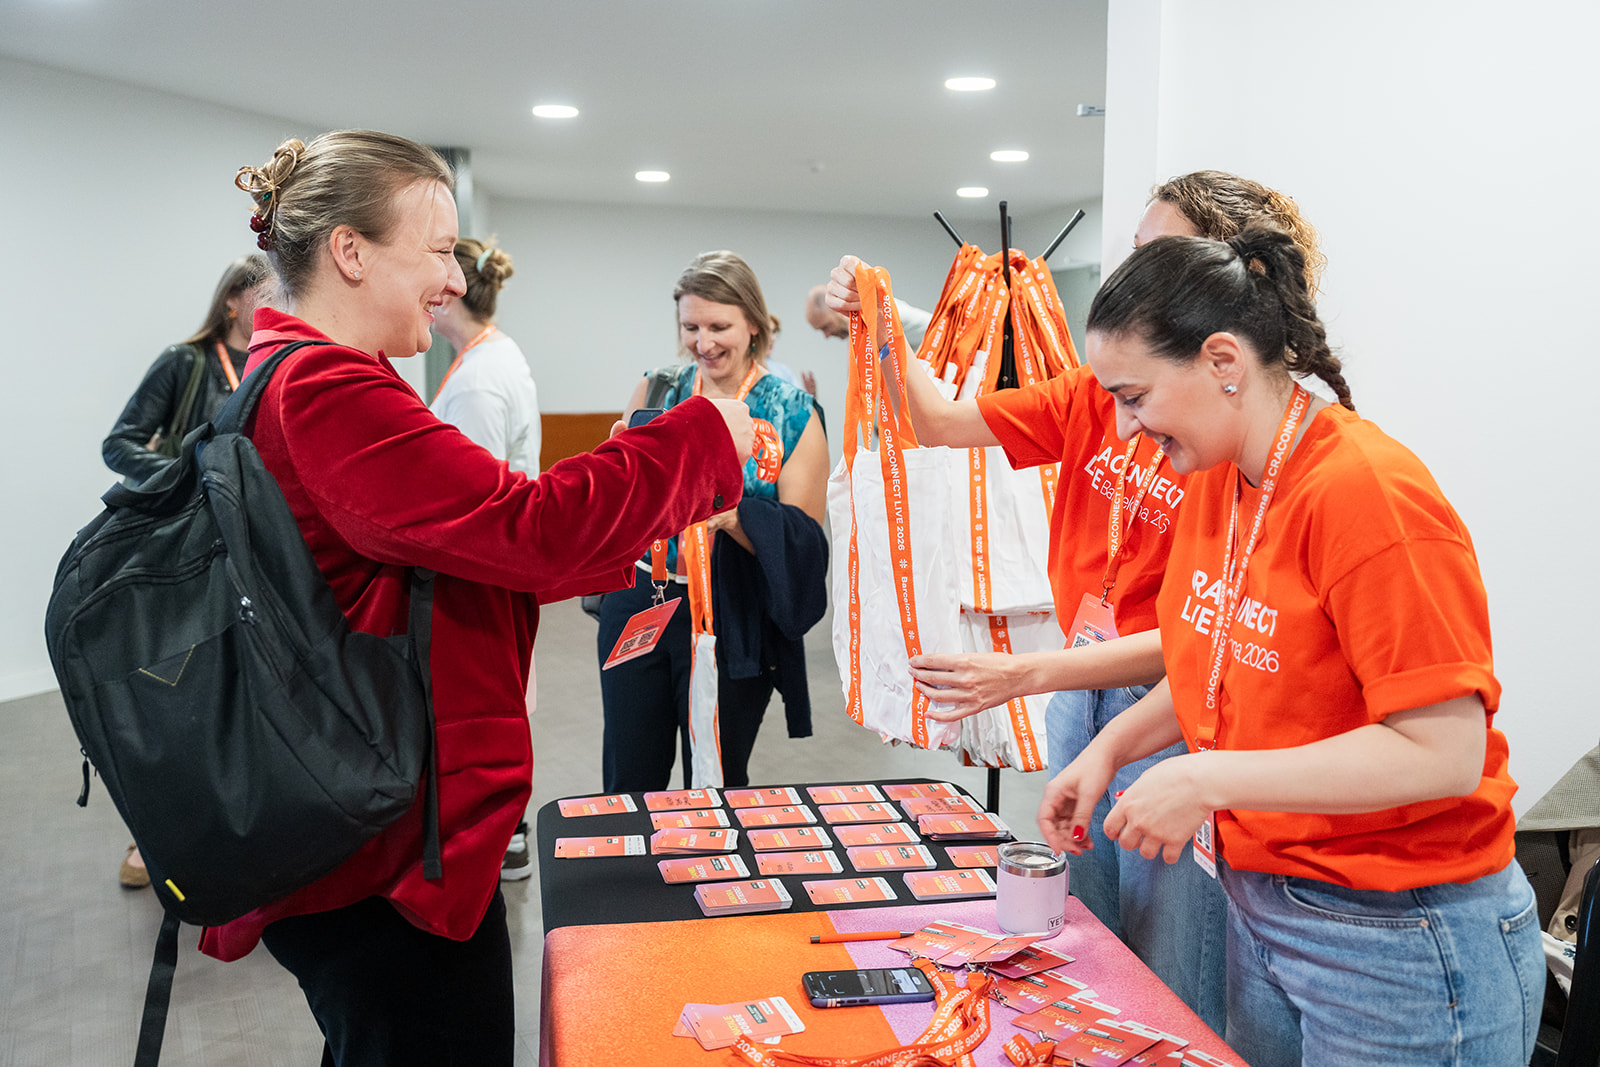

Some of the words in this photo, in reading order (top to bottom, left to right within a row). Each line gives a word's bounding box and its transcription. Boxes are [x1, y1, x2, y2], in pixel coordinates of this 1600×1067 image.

[883, 295, 892, 320] 2026
[865, 368, 873, 390] LIVE
[865, 393, 873, 415] 2026
[1268, 396, 1306, 477] CRACONNECT
[884, 428, 902, 499] CRACONNECT
[894, 500, 904, 524] LIVE
[975, 485, 983, 519] Barcelona
[1110, 491, 1122, 558] CRACONNECT
[896, 525, 906, 551] 2026
[976, 555, 985, 572] LIVE
[901, 576, 912, 623] Barcelona
[1206, 629, 1228, 709] CRACONNECT
[1224, 601, 1236, 629] LIVE
[1232, 570, 1244, 600] 2026
[1246, 494, 1270, 555] Barcelona
[1241, 642, 1280, 673] 2026
[1017, 713, 1027, 732] LIVE
[1039, 1009, 1089, 1029] SPEAKER
[736, 1039, 764, 1063] 2026
[1076, 1037, 1129, 1055] SPEAKER
